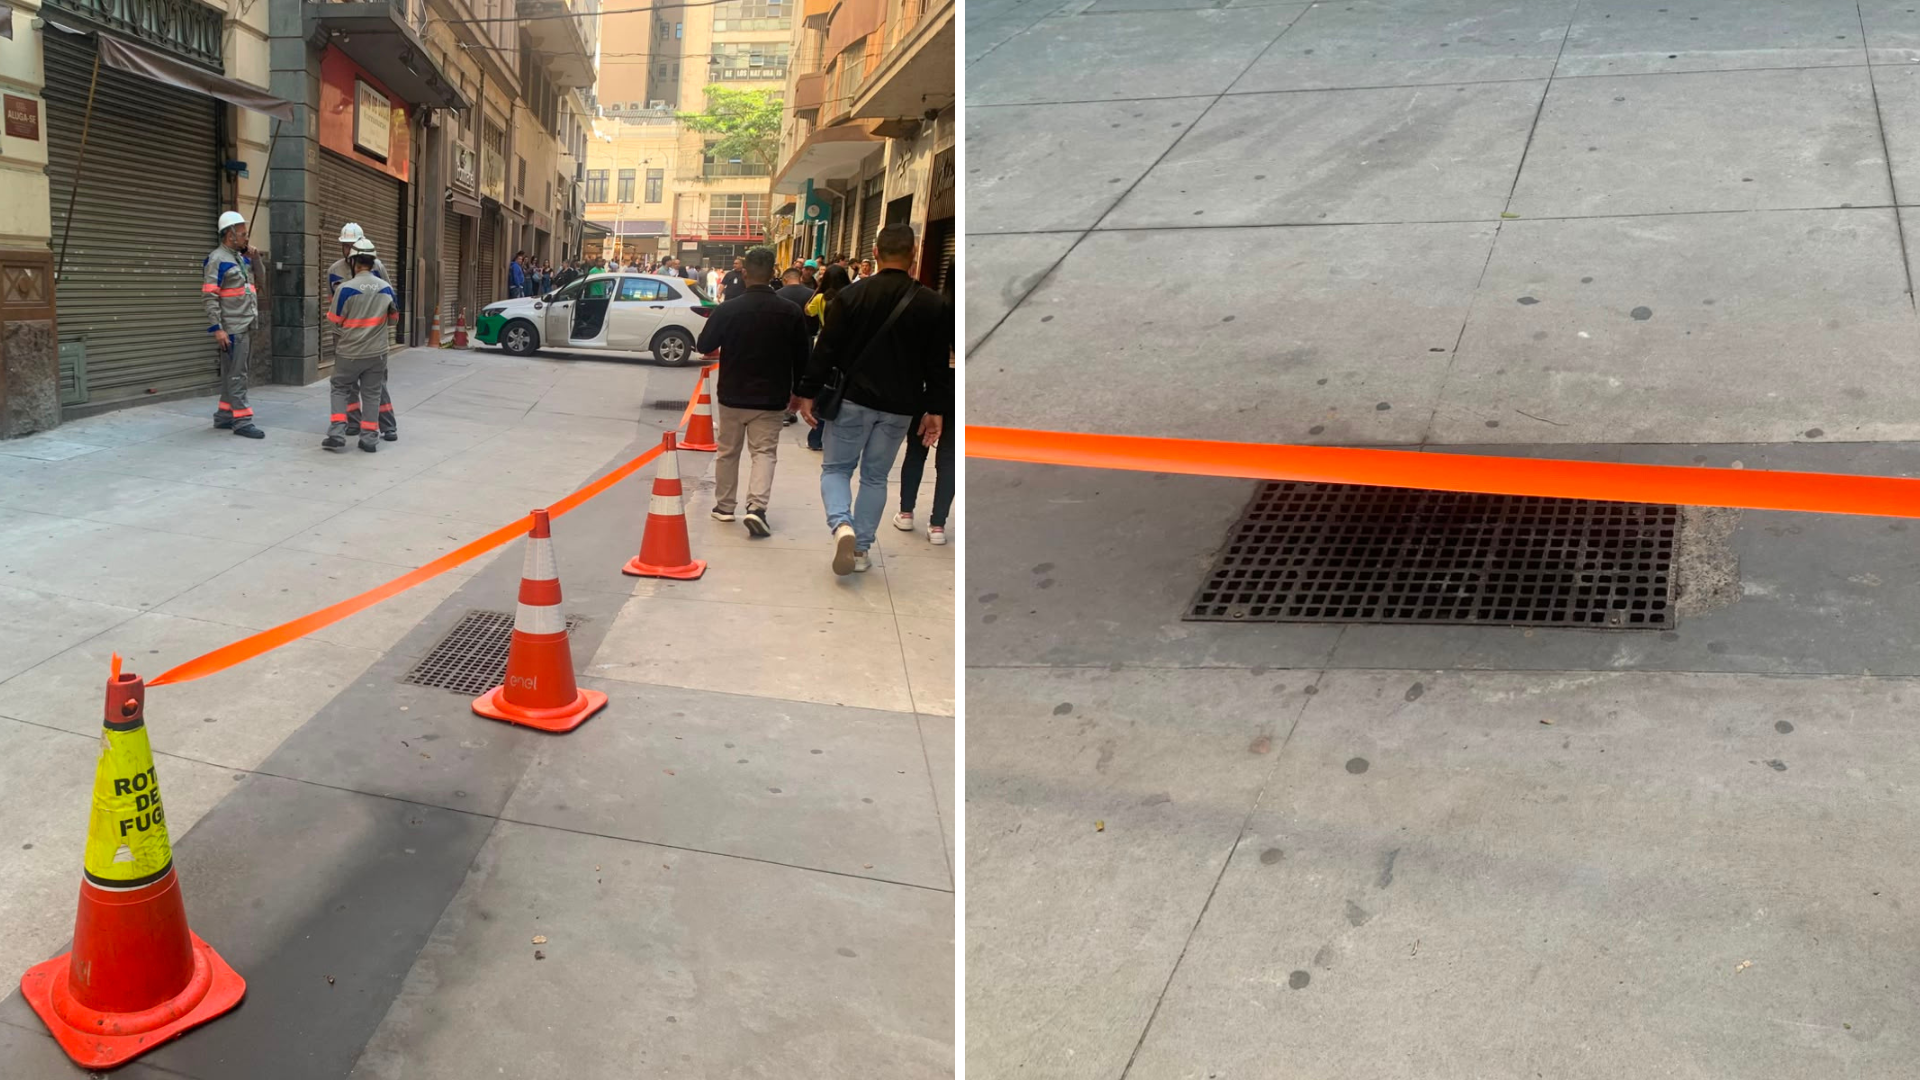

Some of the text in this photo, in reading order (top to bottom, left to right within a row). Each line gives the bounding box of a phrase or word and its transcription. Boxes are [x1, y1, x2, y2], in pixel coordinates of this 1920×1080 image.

[8, 109, 37, 124] ALUGA-SE
[510, 675, 537, 690] enel
[136, 786, 160, 812] DE
[120, 803, 164, 837] FUG
